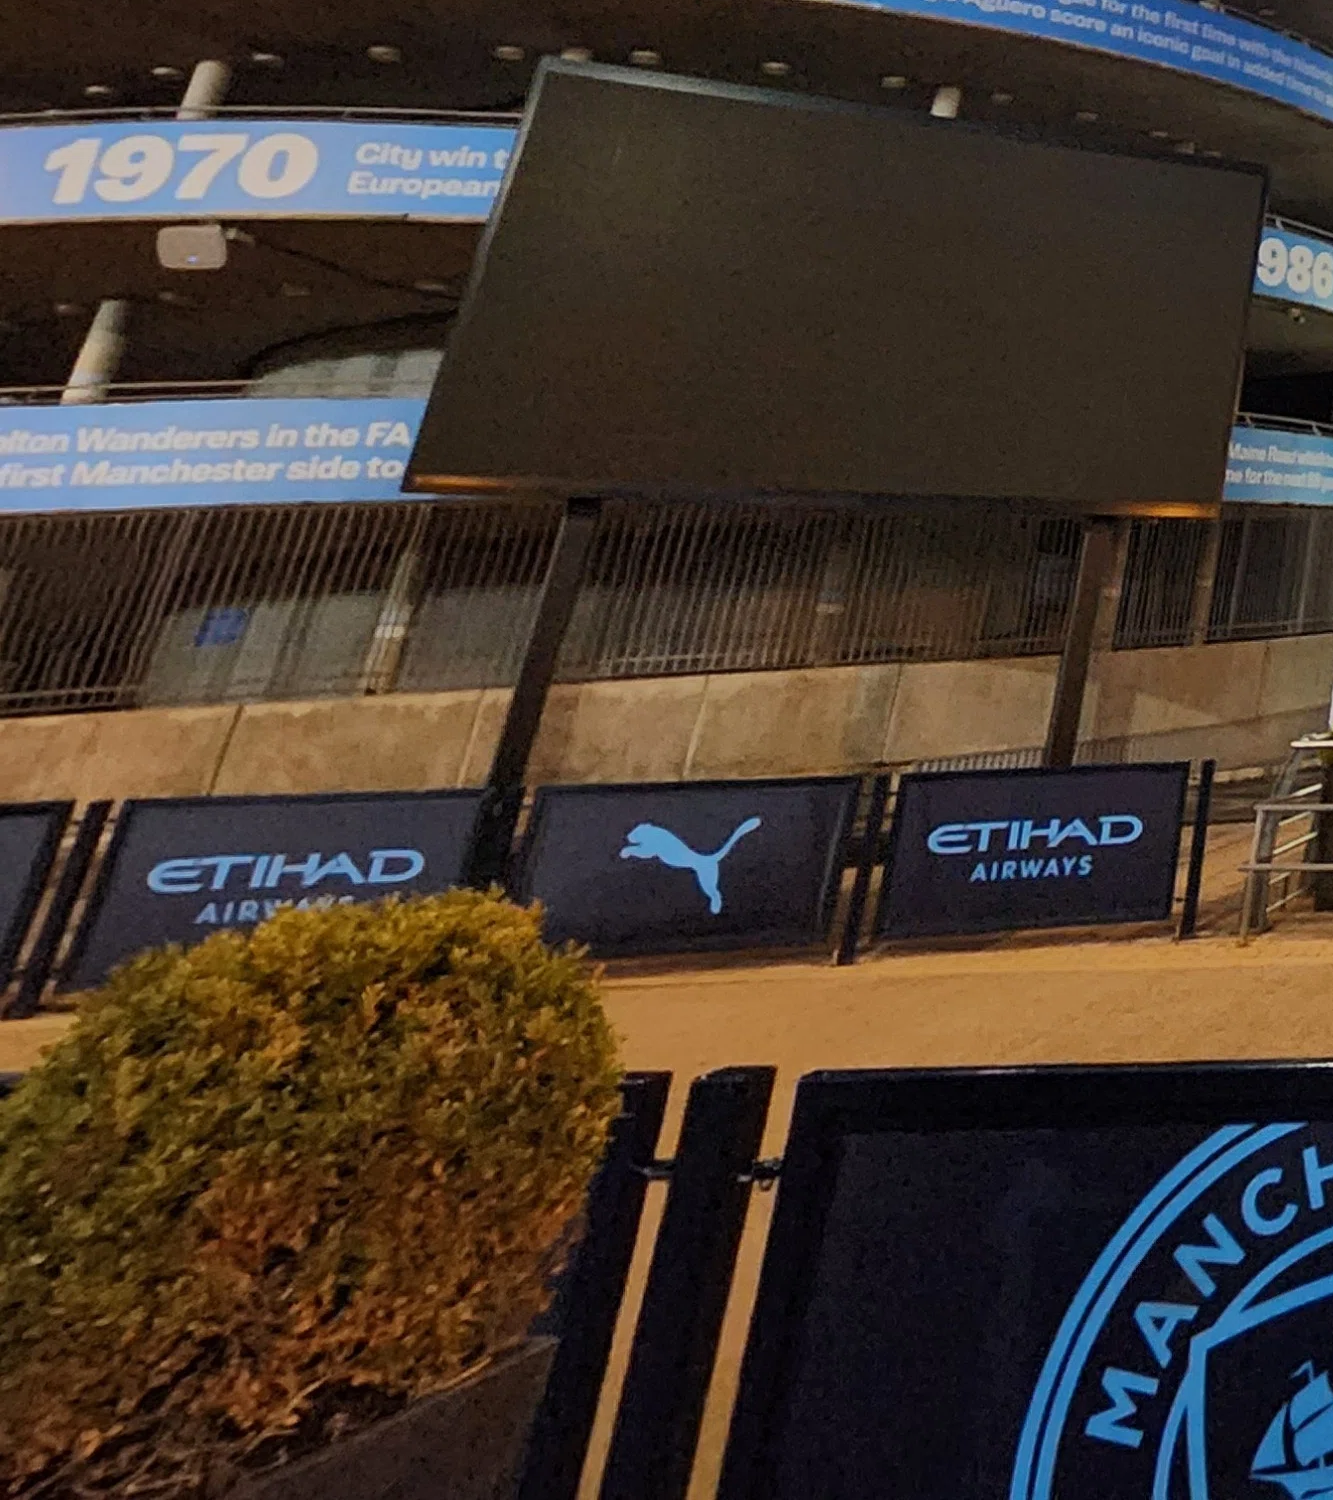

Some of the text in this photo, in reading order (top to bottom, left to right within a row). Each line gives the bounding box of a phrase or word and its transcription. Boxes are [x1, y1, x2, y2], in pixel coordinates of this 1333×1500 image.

[1050, 8, 1106, 32] score
[1110, 21, 1134, 40] an
[1137, 26, 1189, 54] iconic
[1132, 4, 1160, 25] the
[1164, 10, 1199, 35] first
[1201, 23, 1236, 46] time
[44, 133, 319, 203] 1970
[356, 142, 422, 170] City
[429, 146, 487, 168] win
[77, 425, 260, 452] Wanderers
[266, 423, 298, 447] in
[304, 422, 360, 448] the
[366, 421, 410, 447] FA
[70, 458, 283, 486] Manchester
[286, 454, 361, 480] side
[366, 456, 404, 479] to
[928, 815, 1143, 854] ETIHAD
[147, 849, 424, 893] ETIHAD
[970, 855, 1093, 882] AIRWAYS
